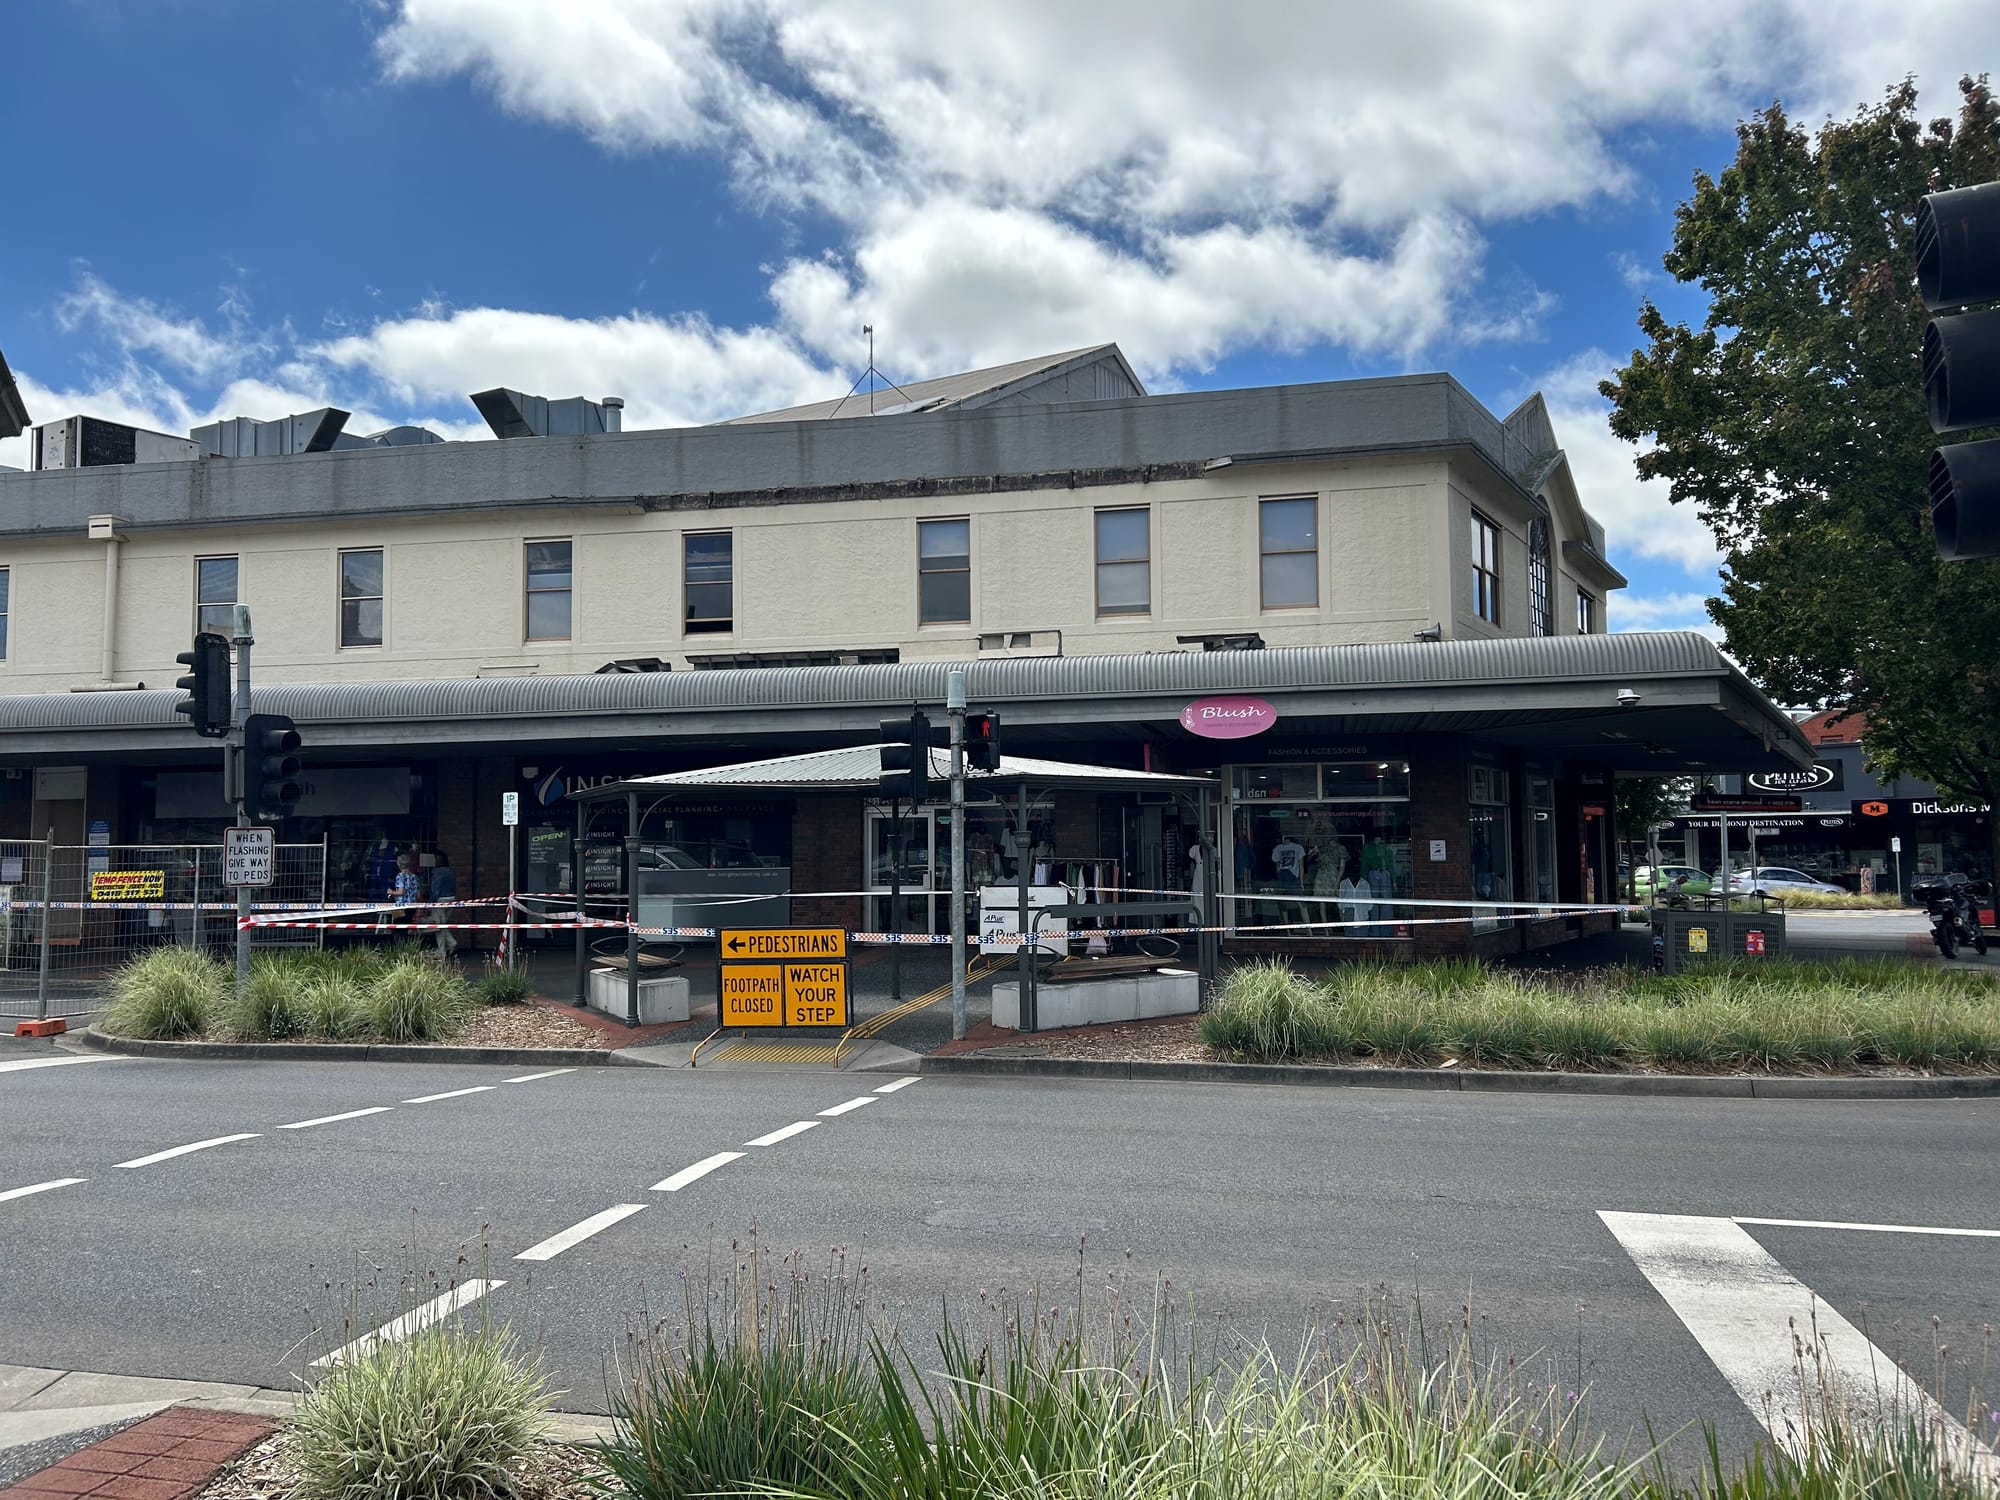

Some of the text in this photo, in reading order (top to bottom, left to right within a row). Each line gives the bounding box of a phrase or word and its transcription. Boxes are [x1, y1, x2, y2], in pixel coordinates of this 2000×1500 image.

[1199, 706, 1267, 719] Blush
[1267, 747, 1302, 756] FASHION
[1310, 746, 1368, 755] ACCESSORIES
[1688, 819, 1804, 828] YOUR DIMOND DESTINATION
[236, 833, 263, 843] WHEN
[532, 831, 565, 843] OPEN
[229, 846, 269, 856] FLASHING
[228, 858, 268, 868] GIVE WAY
[94, 873, 163, 885] TEMP FENCE NOW
[228, 870, 269, 881] TO PEDS
[662, 927, 679, 935] SES
[885, 933, 902, 942] SES
[931, 935, 948, 943] SES
[977, 936, 995, 944] SES
[749, 935, 838, 953] PEDESTRIANS
[790, 968, 840, 983] WATCH
[724, 978, 779, 993] FOOTPATH
[795, 987, 837, 1002] YOUR
[731, 998, 773, 1013] CLOSED
[796, 1007, 836, 1022] STEP
